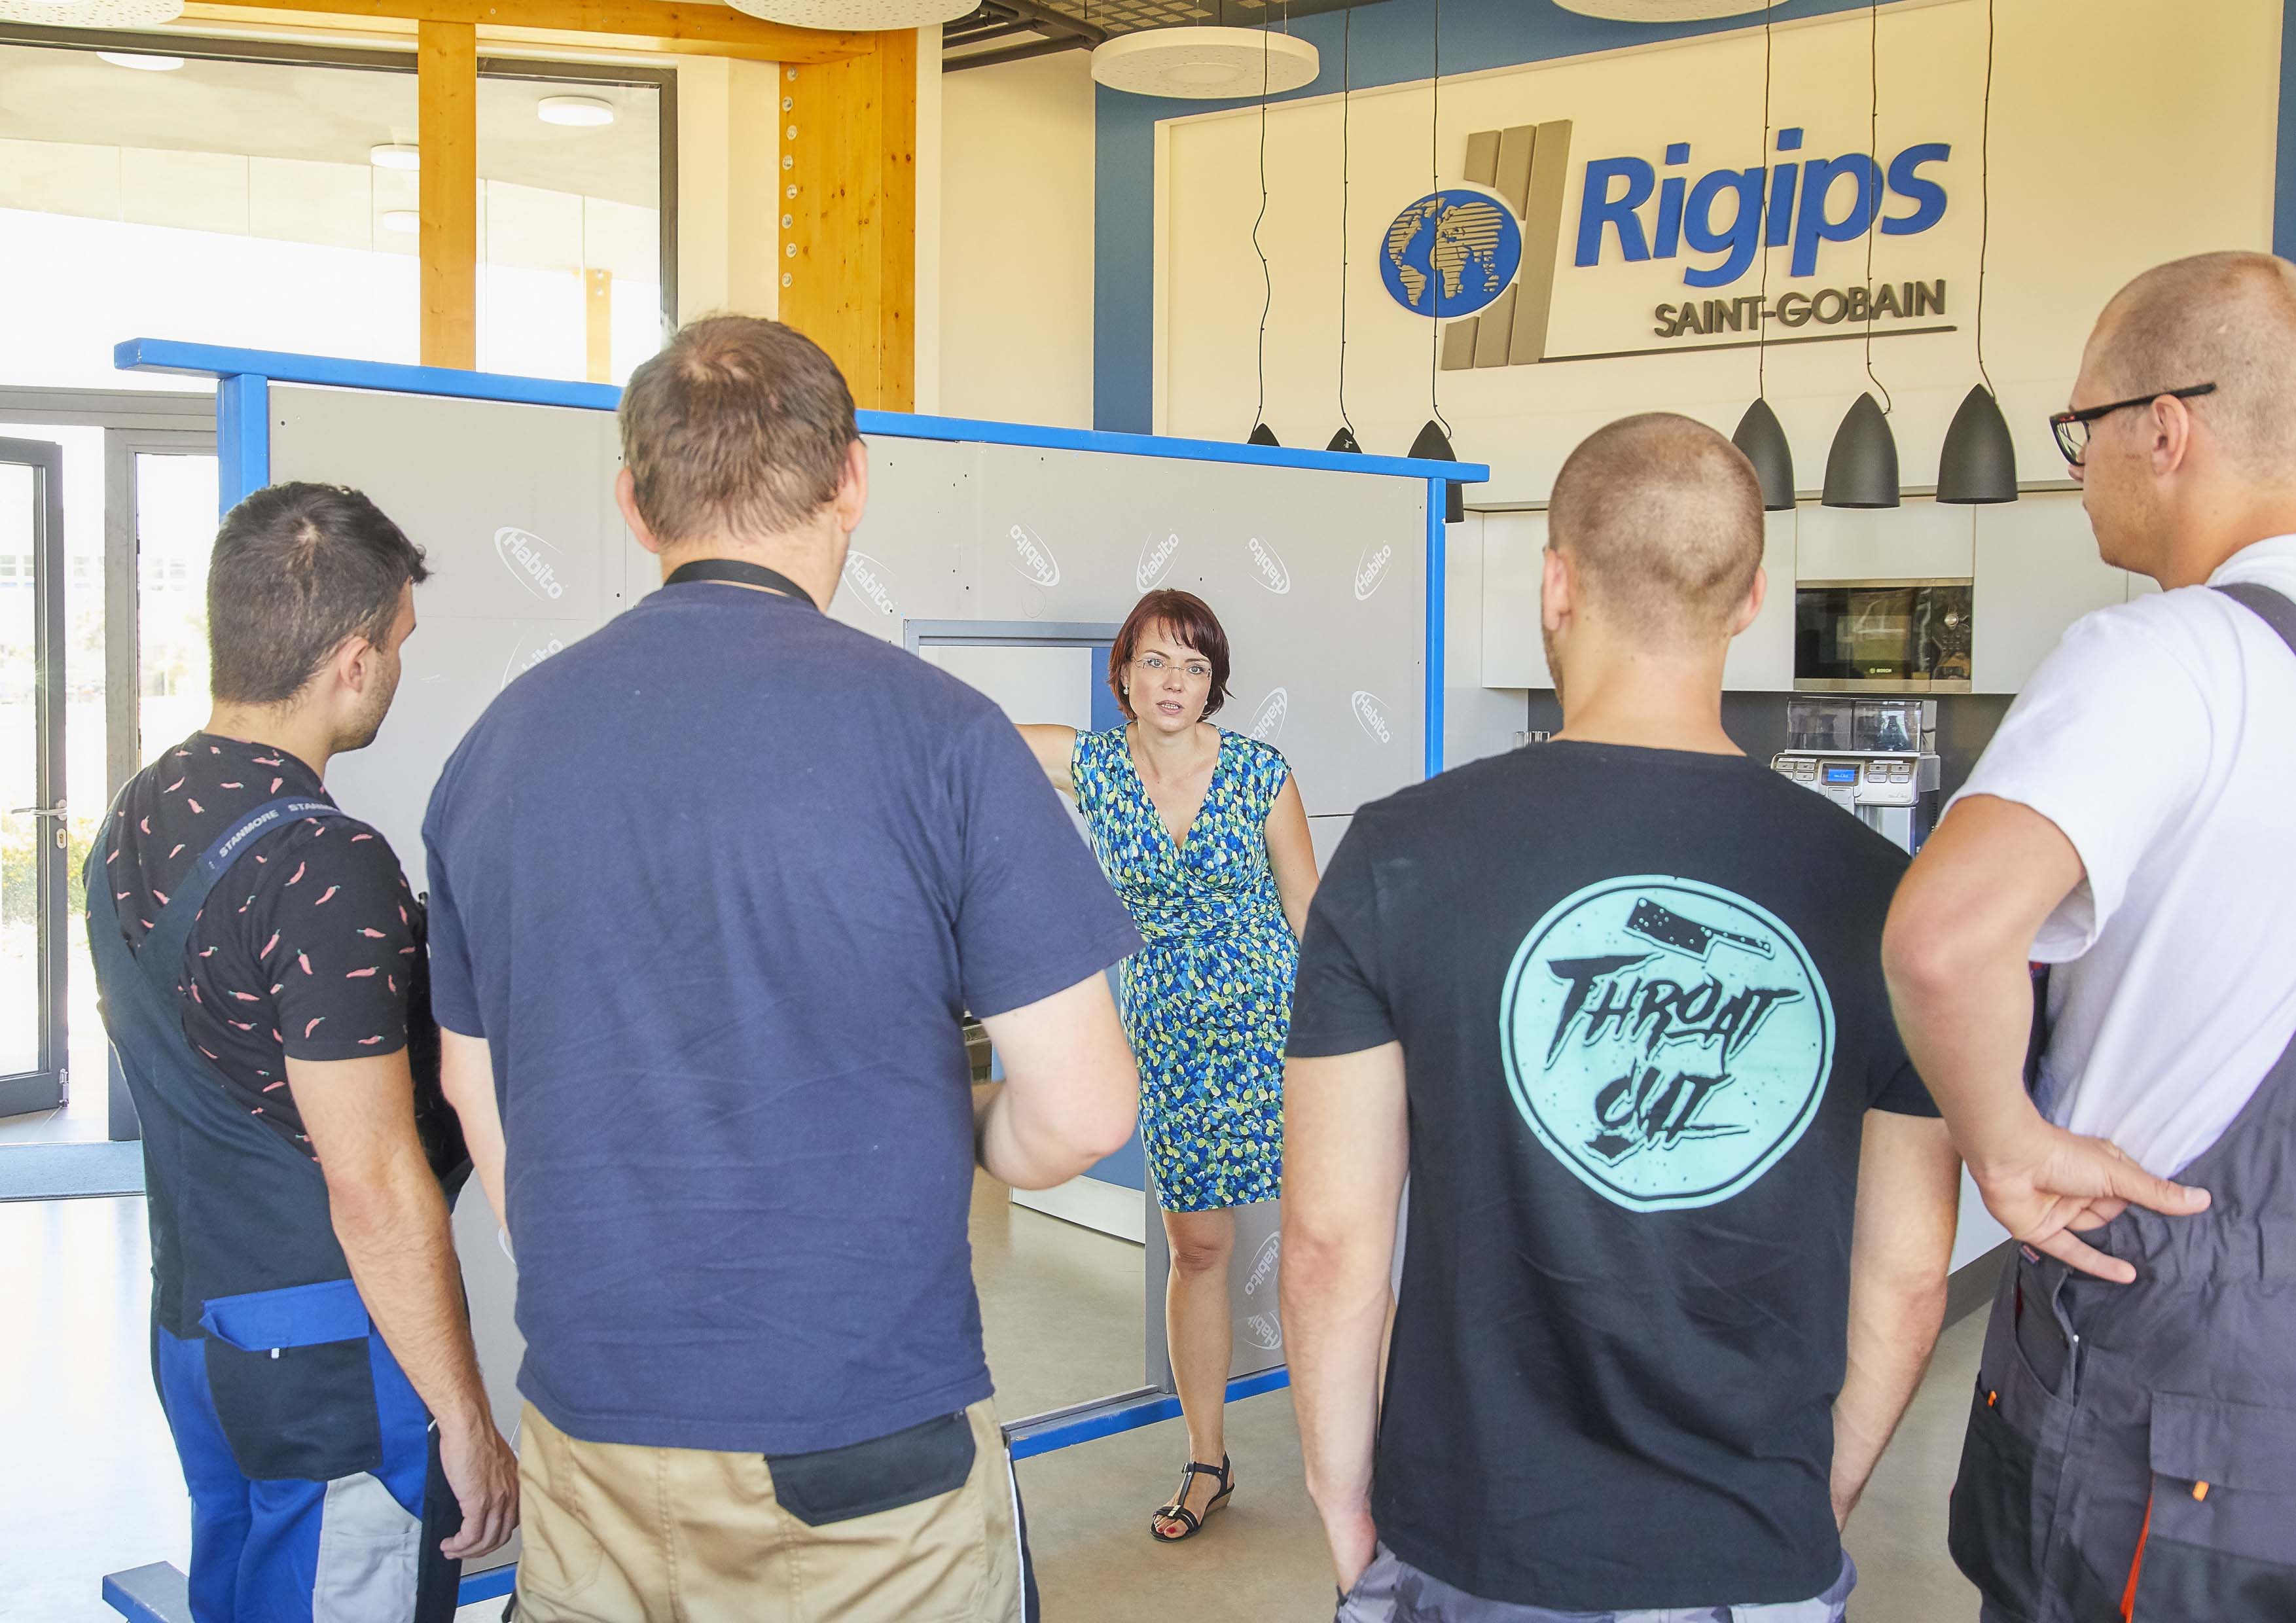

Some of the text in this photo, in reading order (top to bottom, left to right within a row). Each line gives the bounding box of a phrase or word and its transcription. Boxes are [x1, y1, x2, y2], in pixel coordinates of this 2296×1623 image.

[1574, 127, 1952, 288] Rigips
[1653, 279, 1946, 338] SAINT-GOBAIN
[503, 531, 563, 599] Habito
[1010, 524, 1053, 582] Habito
[1138, 533, 1179, 586] Habito
[1249, 537, 1285, 590] Habito
[1356, 544, 1391, 593] Habito
[845, 554, 893, 615] Habito
[1357, 694, 1390, 743] Habito
[219, 810, 279, 857] STANMORE
[1545, 953, 1805, 1075] THROAT
[1245, 1240, 1279, 1295] Habito
